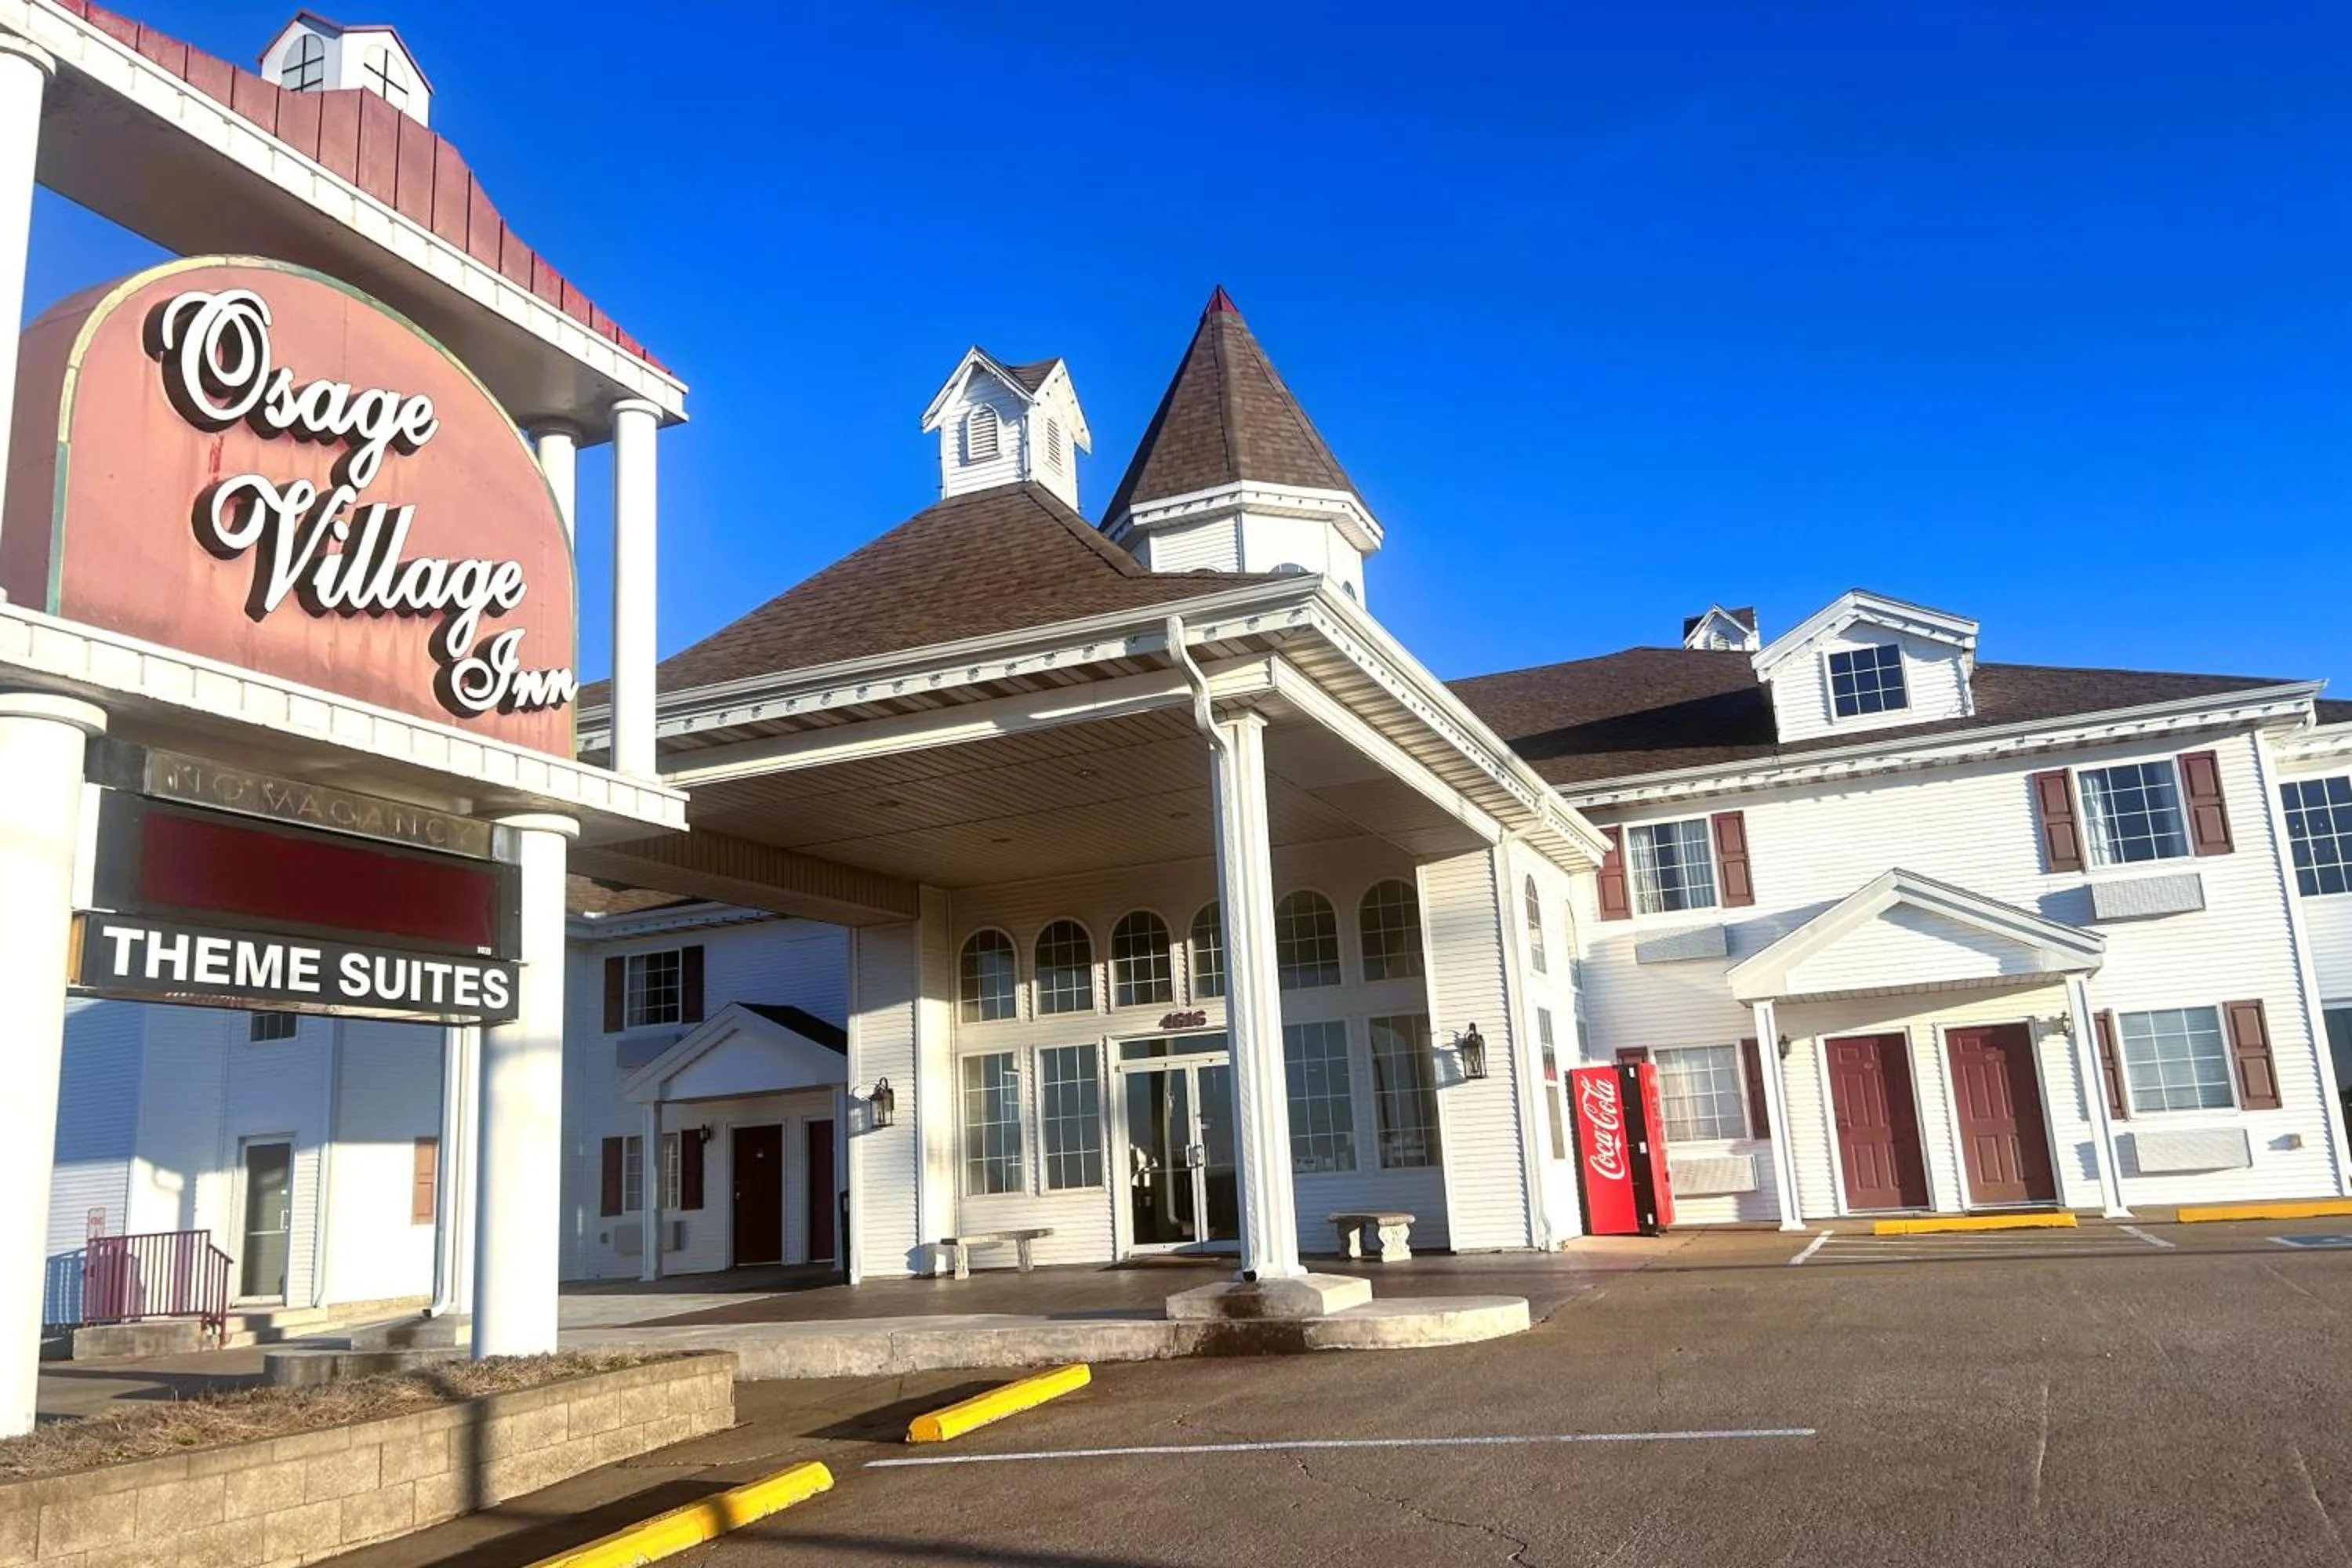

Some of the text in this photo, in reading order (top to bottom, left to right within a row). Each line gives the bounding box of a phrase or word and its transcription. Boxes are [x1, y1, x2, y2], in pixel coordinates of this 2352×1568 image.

[159, 289, 440, 489] Osage
[209, 473, 528, 657] Village
[449, 628, 578, 711] Inn
[103, 925, 510, 1009] THEME SUITES
